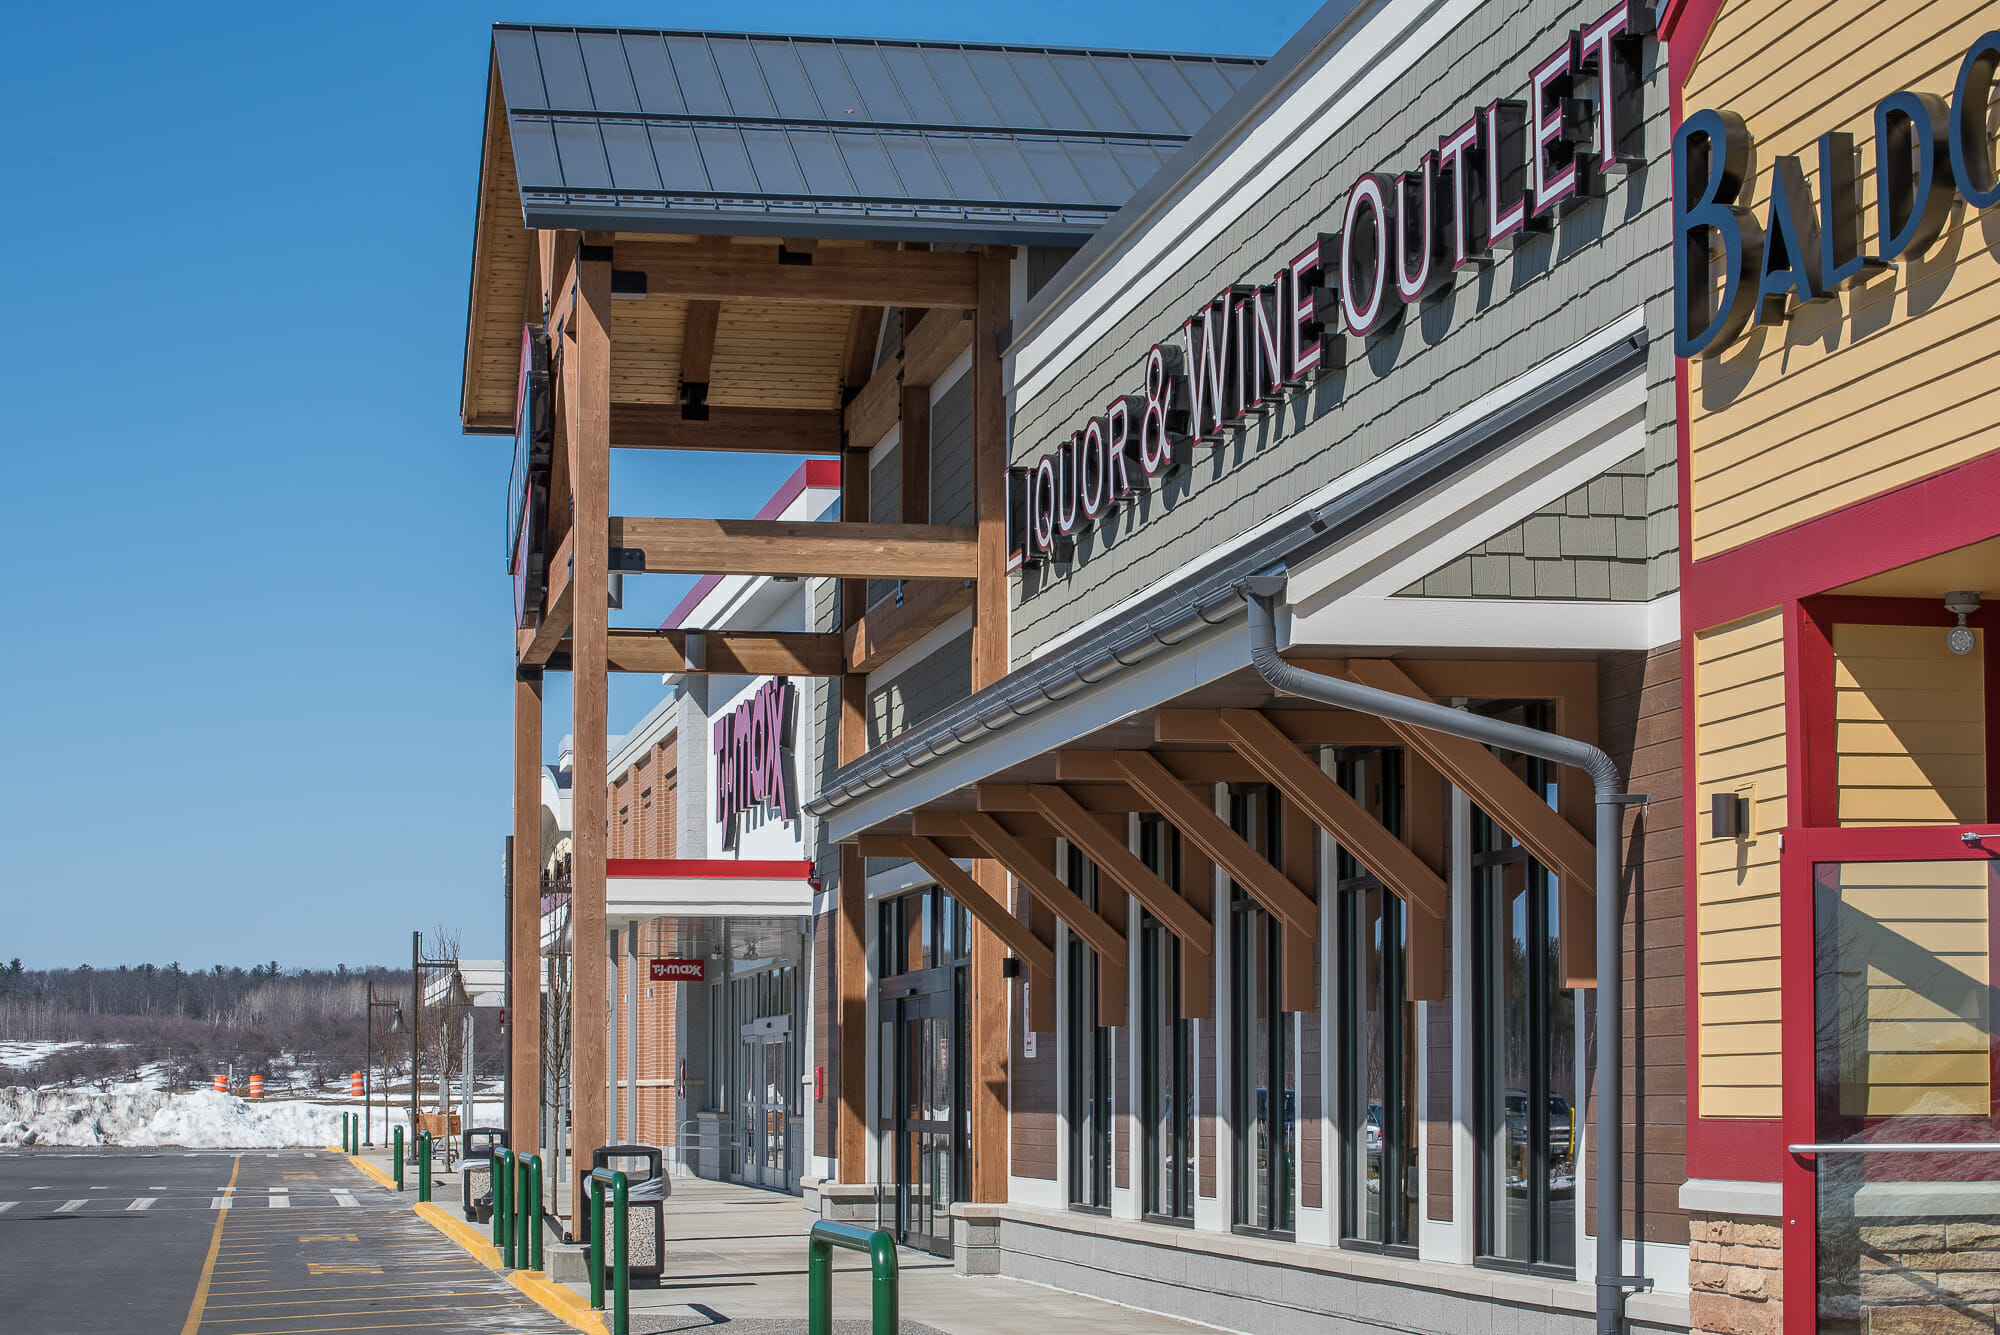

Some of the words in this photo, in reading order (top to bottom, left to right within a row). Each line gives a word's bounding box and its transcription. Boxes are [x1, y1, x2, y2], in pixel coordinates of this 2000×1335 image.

[1004, 394, 1131, 577] LIQUOR
[1139, 344, 1174, 478] &
[1182, 240, 1323, 447] WINE
[1340, 2, 1628, 338] OUTLET
